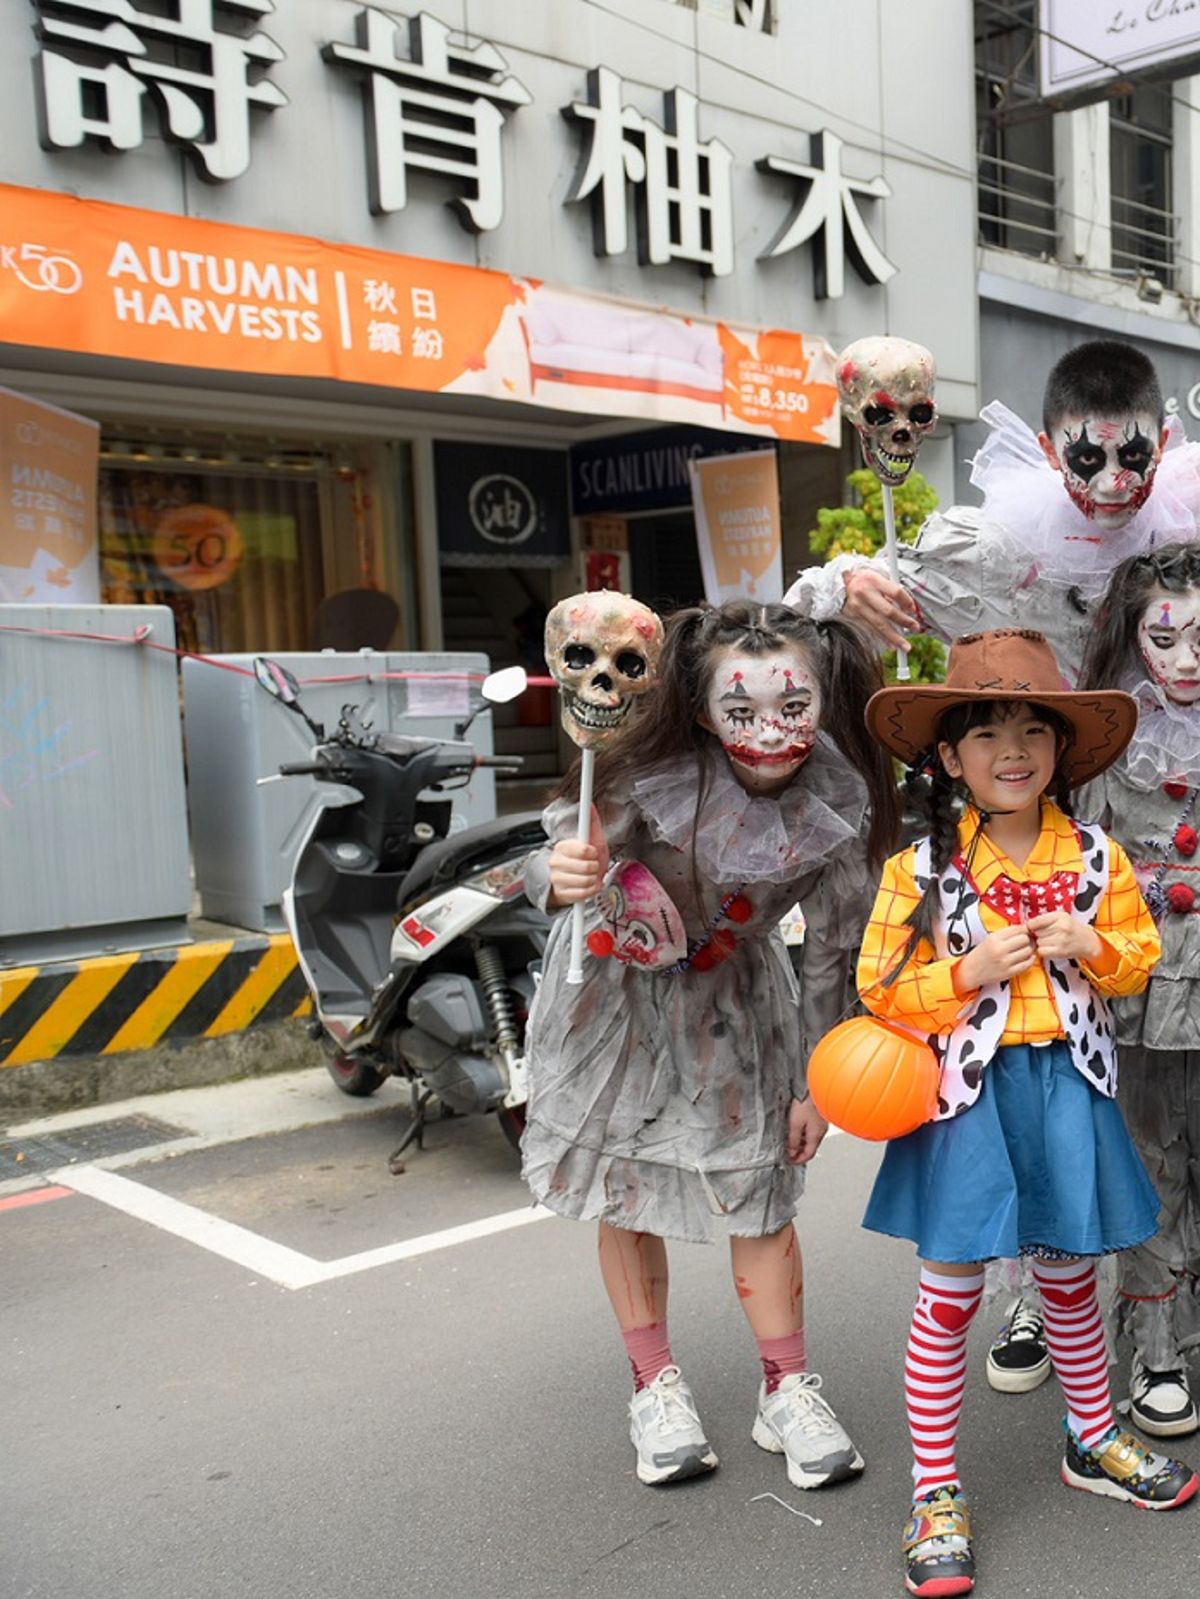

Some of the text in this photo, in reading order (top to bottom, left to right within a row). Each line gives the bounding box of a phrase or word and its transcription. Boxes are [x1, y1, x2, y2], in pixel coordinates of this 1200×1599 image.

[107, 241, 319, 305] AUTUMN
[113, 286, 323, 345] HARVESTS
[363, 279, 438, 322] 秋日
[168, 533, 227, 568] 50
